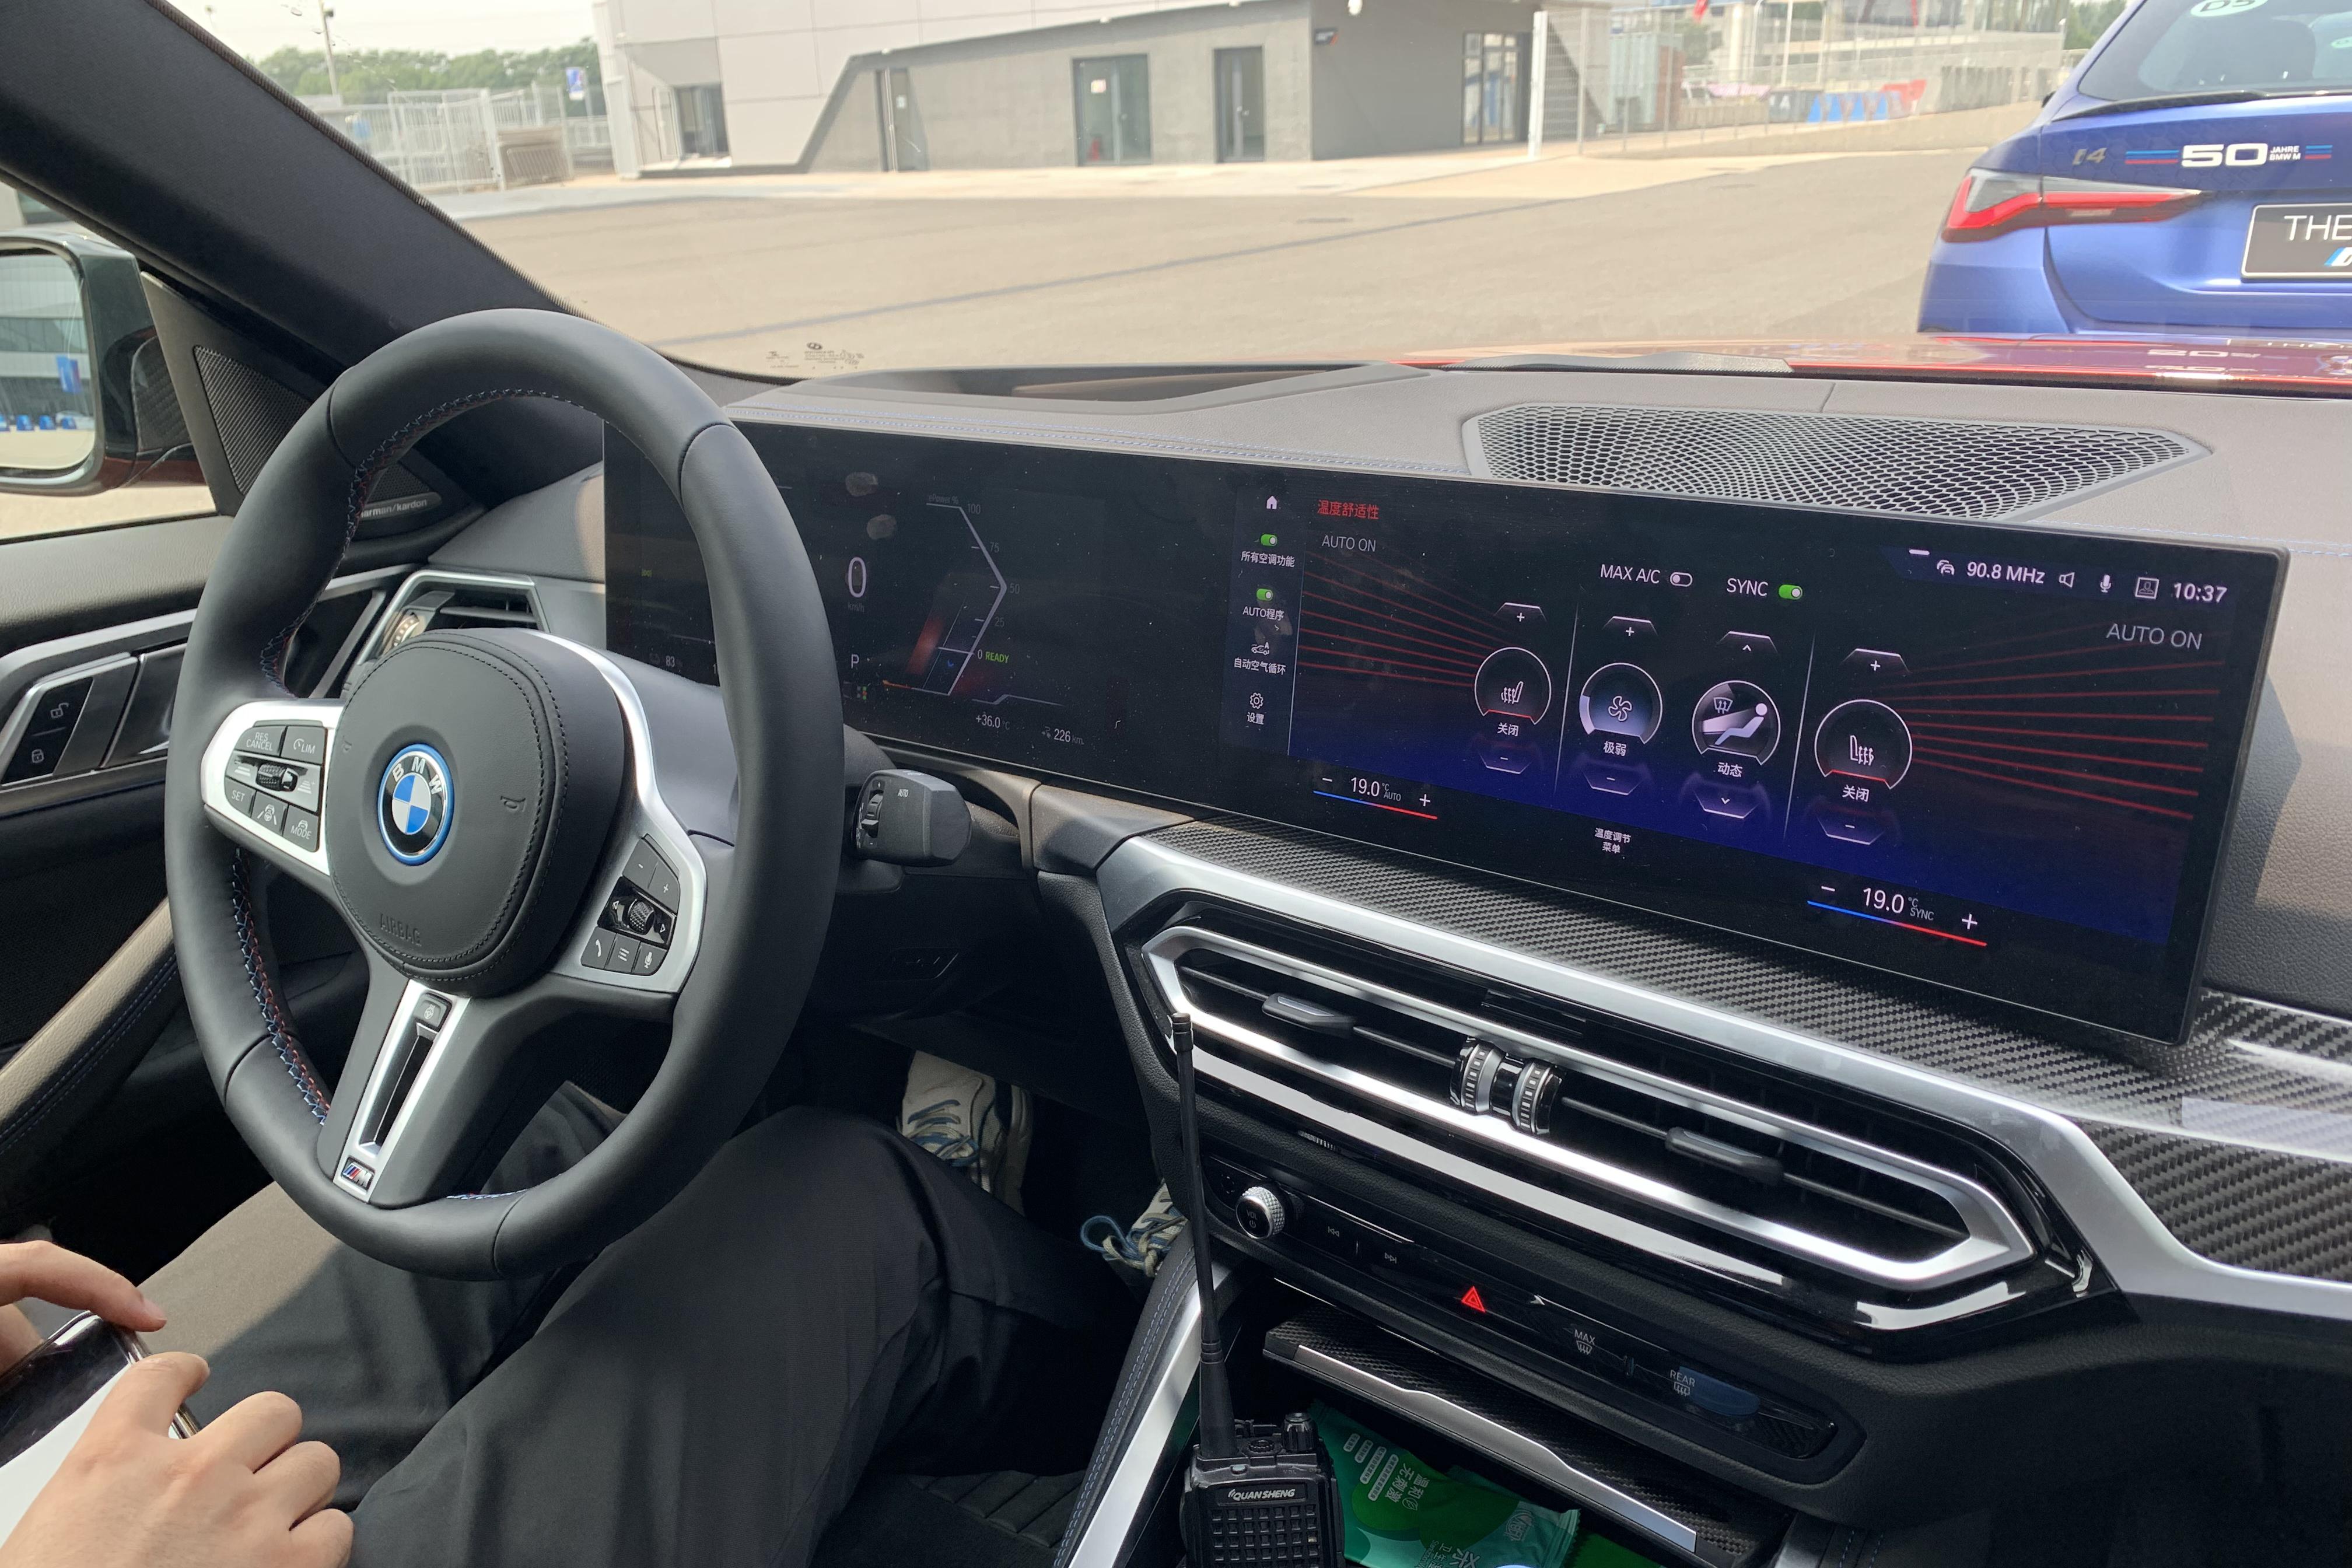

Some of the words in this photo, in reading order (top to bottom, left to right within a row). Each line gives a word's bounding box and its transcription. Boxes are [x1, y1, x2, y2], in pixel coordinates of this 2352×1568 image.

[2181, 143, 2269, 167] 50
[2269, 145, 2300, 153] JAHRE
[2269, 153, 2291, 161] BMW
[2292, 152, 2301, 160] M
[2284, 214, 2352, 240] THE
[361, 499, 427, 518] arman/kardon
[968, 503, 981, 514] 100
[1317, 499, 1379, 520] 温度舒适性
[990, 542, 999, 553] 75
[1322, 534, 1355, 551] AUTO
[1358, 538, 1376, 552] ON
[1241, 551, 1295, 568] 所有空调功能
[848, 556, 866, 598] 0
[1600, 564, 1633, 581] MAX
[1636, 568, 1660, 584] A/C
[1966, 561, 2001, 580] 90.8
[2006, 565, 2045, 584] MHz
[1009, 583, 1020, 594] 50
[1727, 578, 1768, 597] SYNC
[2174, 582, 2227, 603] 10:37
[995, 616, 1005, 628] 25
[1242, 605, 1284, 622] AUTO程序
[2106, 623, 2164, 645] AUTO
[2171, 629, 2202, 650] ON
[666, 655, 675, 668] 83
[850, 653, 860, 669] P
[985, 651, 1009, 664] READY
[1233, 657, 1286, 676] 自动空气循环
[976, 713, 1000, 729] +36.0
[1247, 712, 1264, 725] 设置
[254, 732, 269, 742] RES
[1054, 728, 1071, 743] 226
[1497, 723, 1518, 737] 关闭
[246, 739, 273, 752] CANCEL
[301, 743, 315, 754] LIM
[1603, 740, 1627, 757] 极弱
[392, 756, 443, 796] BMW
[1717, 761, 1742, 778] 动态
[232, 789, 245, 802] SET
[897, 789, 909, 797] AUTO
[1351, 777, 1380, 797] 19.0
[1842, 785, 1870, 802] 关闭
[1384, 791, 1401, 802] AUTO
[290, 825, 312, 840] MODE
[1594, 827, 1631, 844] 温度调节
[1602, 842, 1620, 855] 菜单
[1863, 887, 1905, 915] 19.0
[1909, 906, 1934, 922] SYNC
[380, 913, 422, 947] AIRBAG
[1246, 1208, 1258, 1220] VOL
[1574, 1329, 1595, 1345] MAX
[1670, 1369, 1696, 1387] REAR
[1385, 1463, 1415, 1503] 无刺激
[1408, 1474, 1430, 1499] 温和
